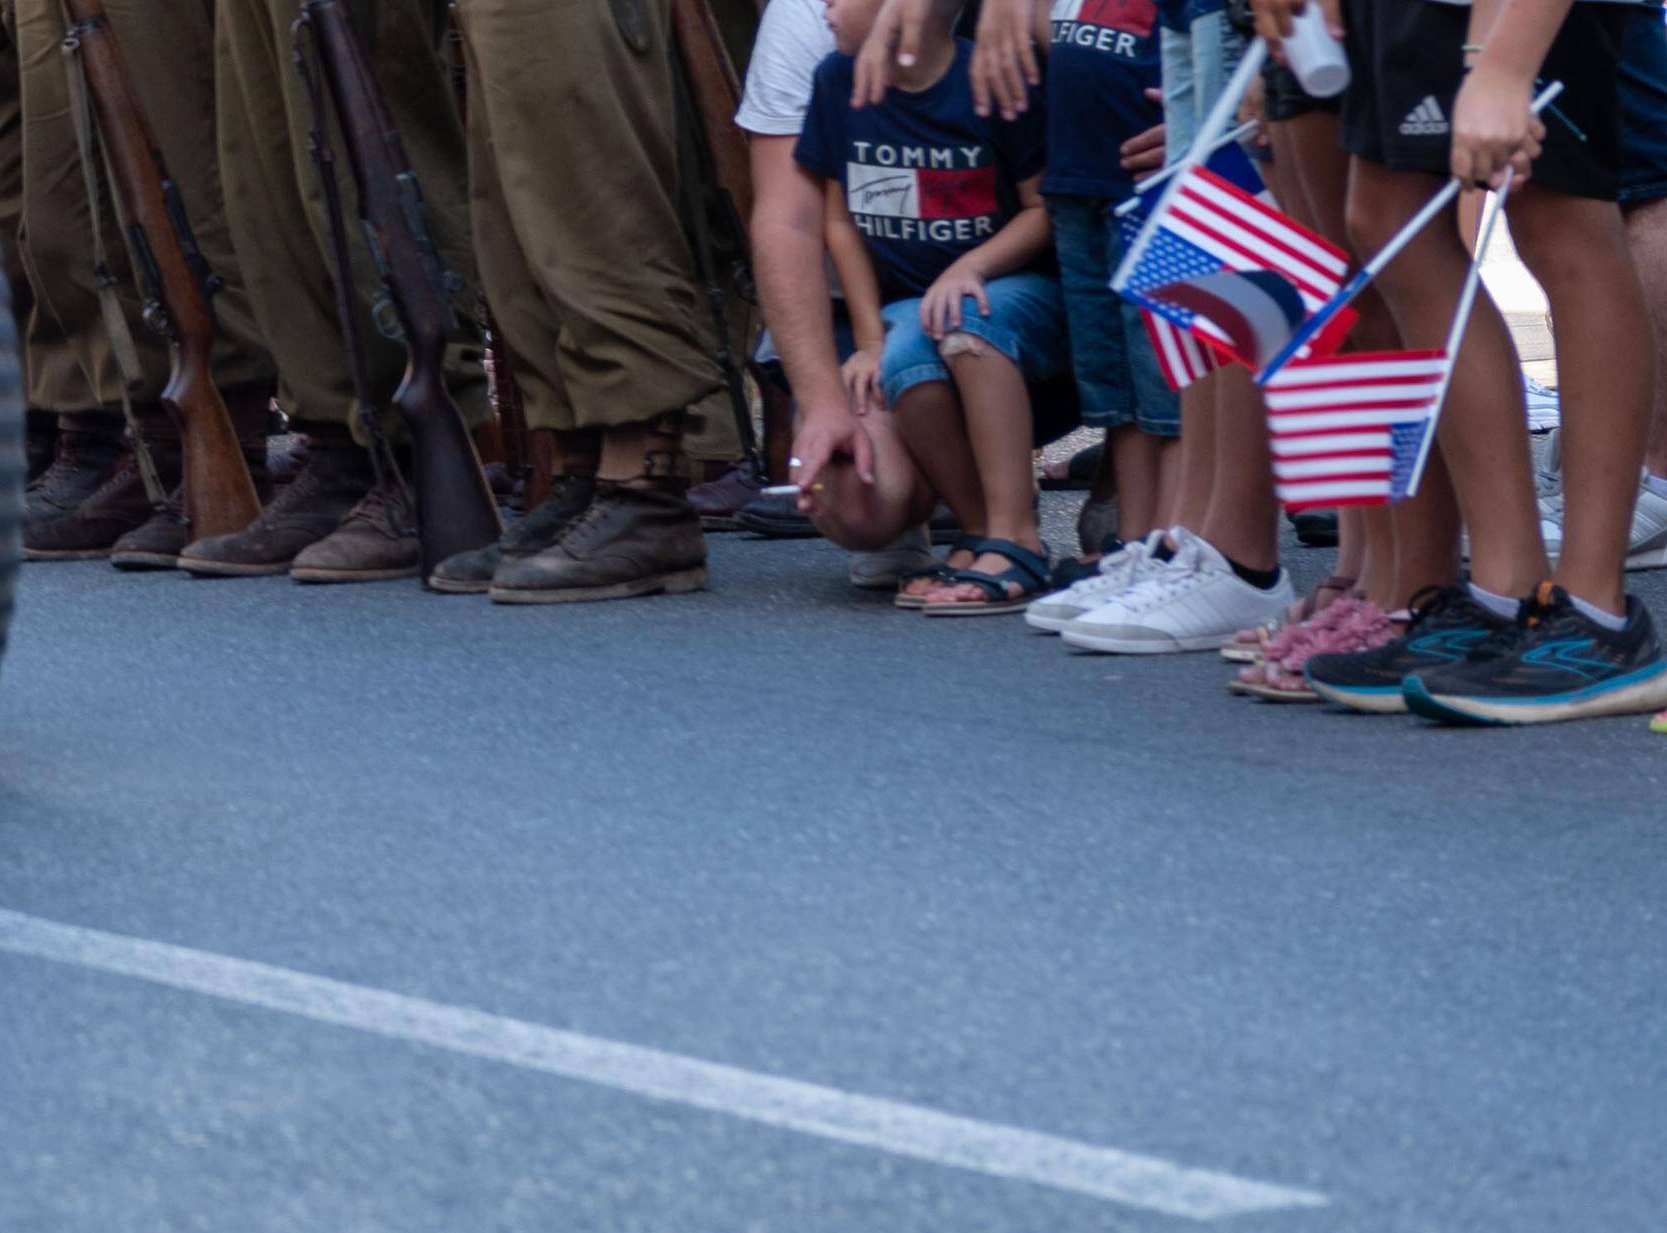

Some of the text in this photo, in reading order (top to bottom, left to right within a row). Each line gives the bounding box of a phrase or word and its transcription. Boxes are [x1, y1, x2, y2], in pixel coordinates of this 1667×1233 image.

[1051, 21, 1138, 58] LFIGER
[853, 141, 982, 169] TOMMY
[854, 214, 994, 242] HILFIGER
